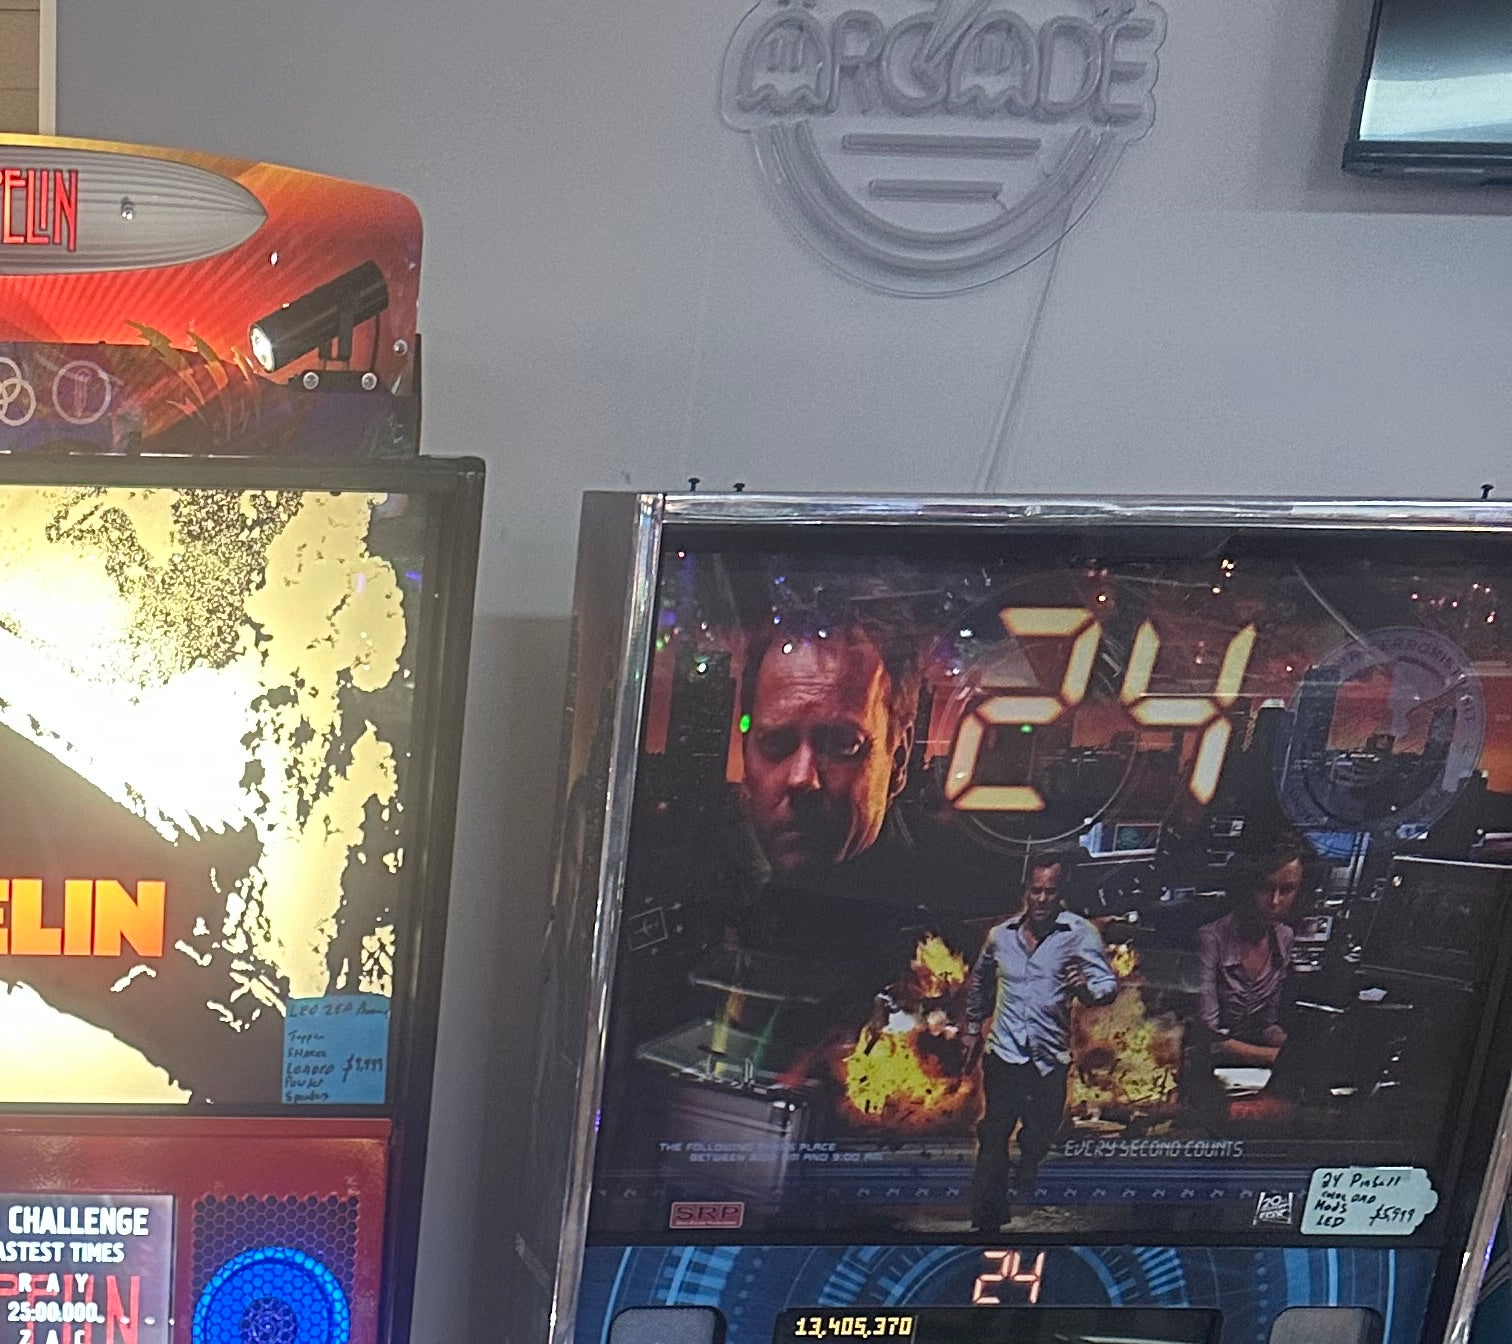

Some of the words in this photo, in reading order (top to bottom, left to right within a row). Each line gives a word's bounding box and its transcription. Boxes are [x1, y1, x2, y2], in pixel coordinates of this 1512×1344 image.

[736, 6, 1156, 126] ARCADE
[945, 606, 1258, 810] 24
[659, 1142, 683, 1152] THE
[799, 1142, 837, 1152] PLACE
[1064, 1140, 1117, 1158] EVERY
[1119, 1140, 1182, 1158] SECOND
[1184, 1140, 1244, 1158] COUNTS
[7, 1204, 149, 1236] CHALLENGE
[675, 1206, 739, 1221] SRP
[1316, 1215, 1345, 1228] LED
[69, 1242, 125, 1263] TIMES
[971, 1250, 1046, 1305] 24
[794, 1317, 913, 1339] 13,405,370
